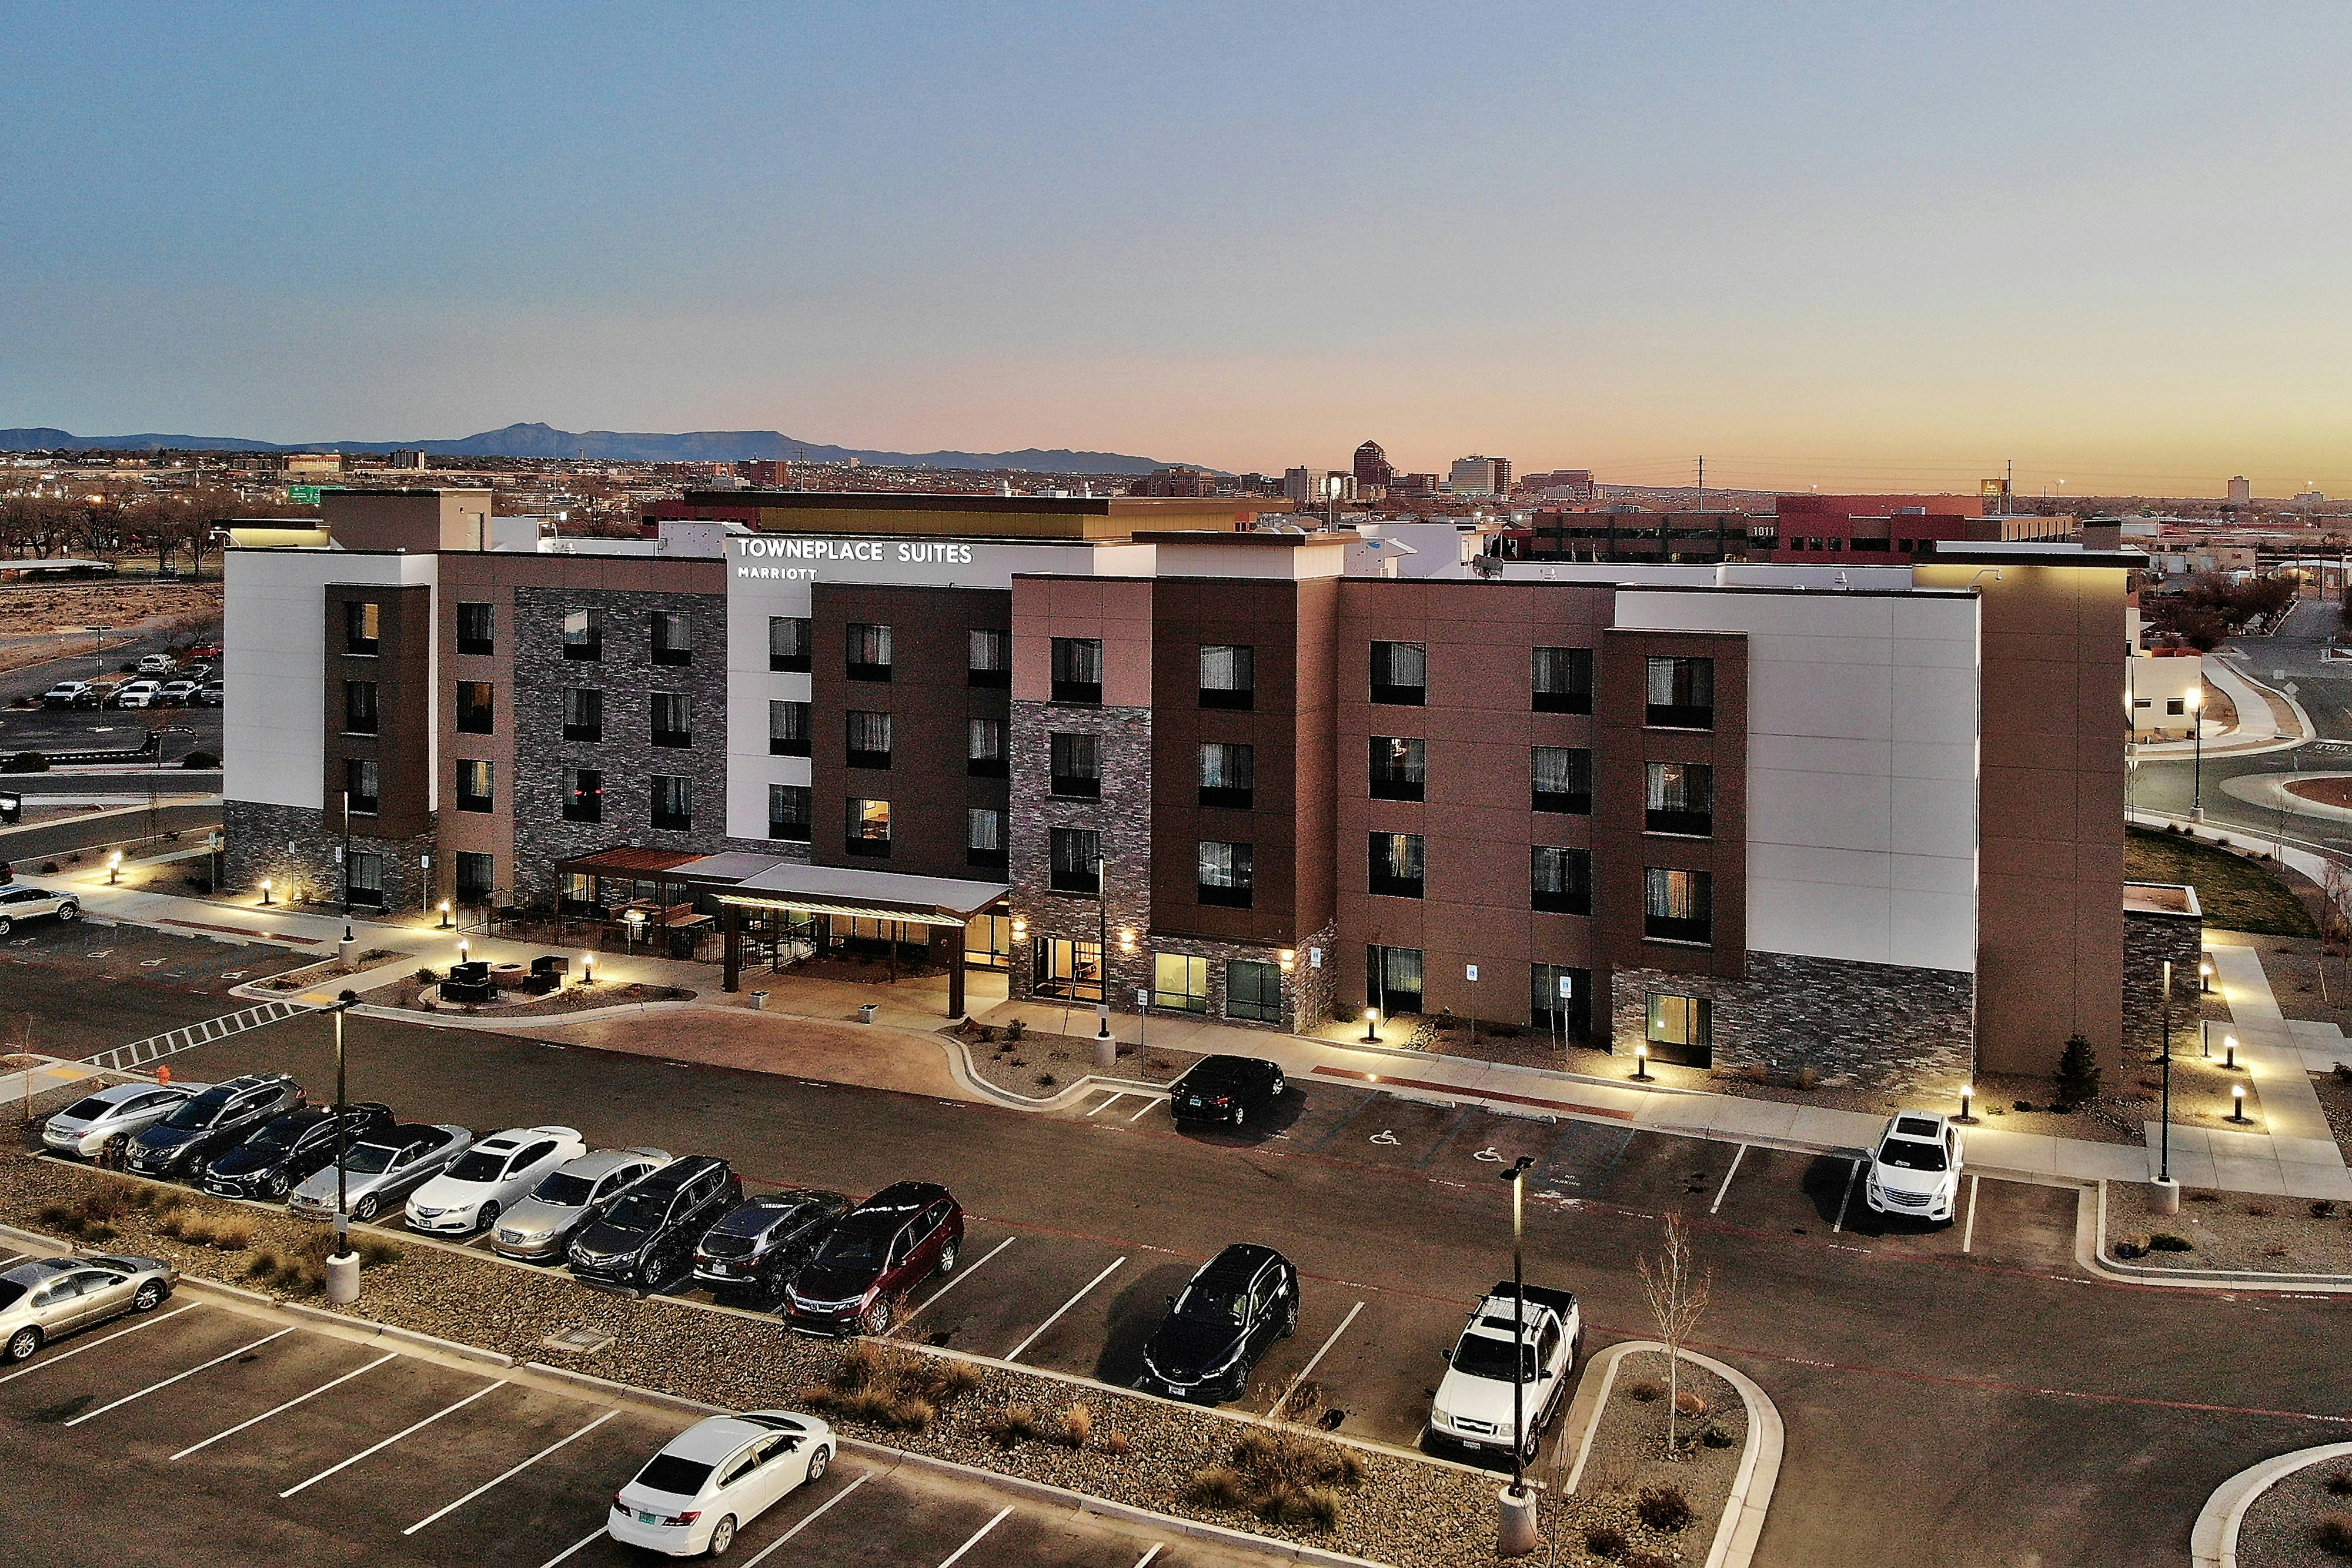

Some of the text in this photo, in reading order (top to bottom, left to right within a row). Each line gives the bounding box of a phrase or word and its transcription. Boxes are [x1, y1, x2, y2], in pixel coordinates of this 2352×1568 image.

[1753, 526, 1773, 536] 1011
[737, 539, 973, 564] TOWNEPLACE SUITES
[738, 567, 818, 580] MARRIOTT
